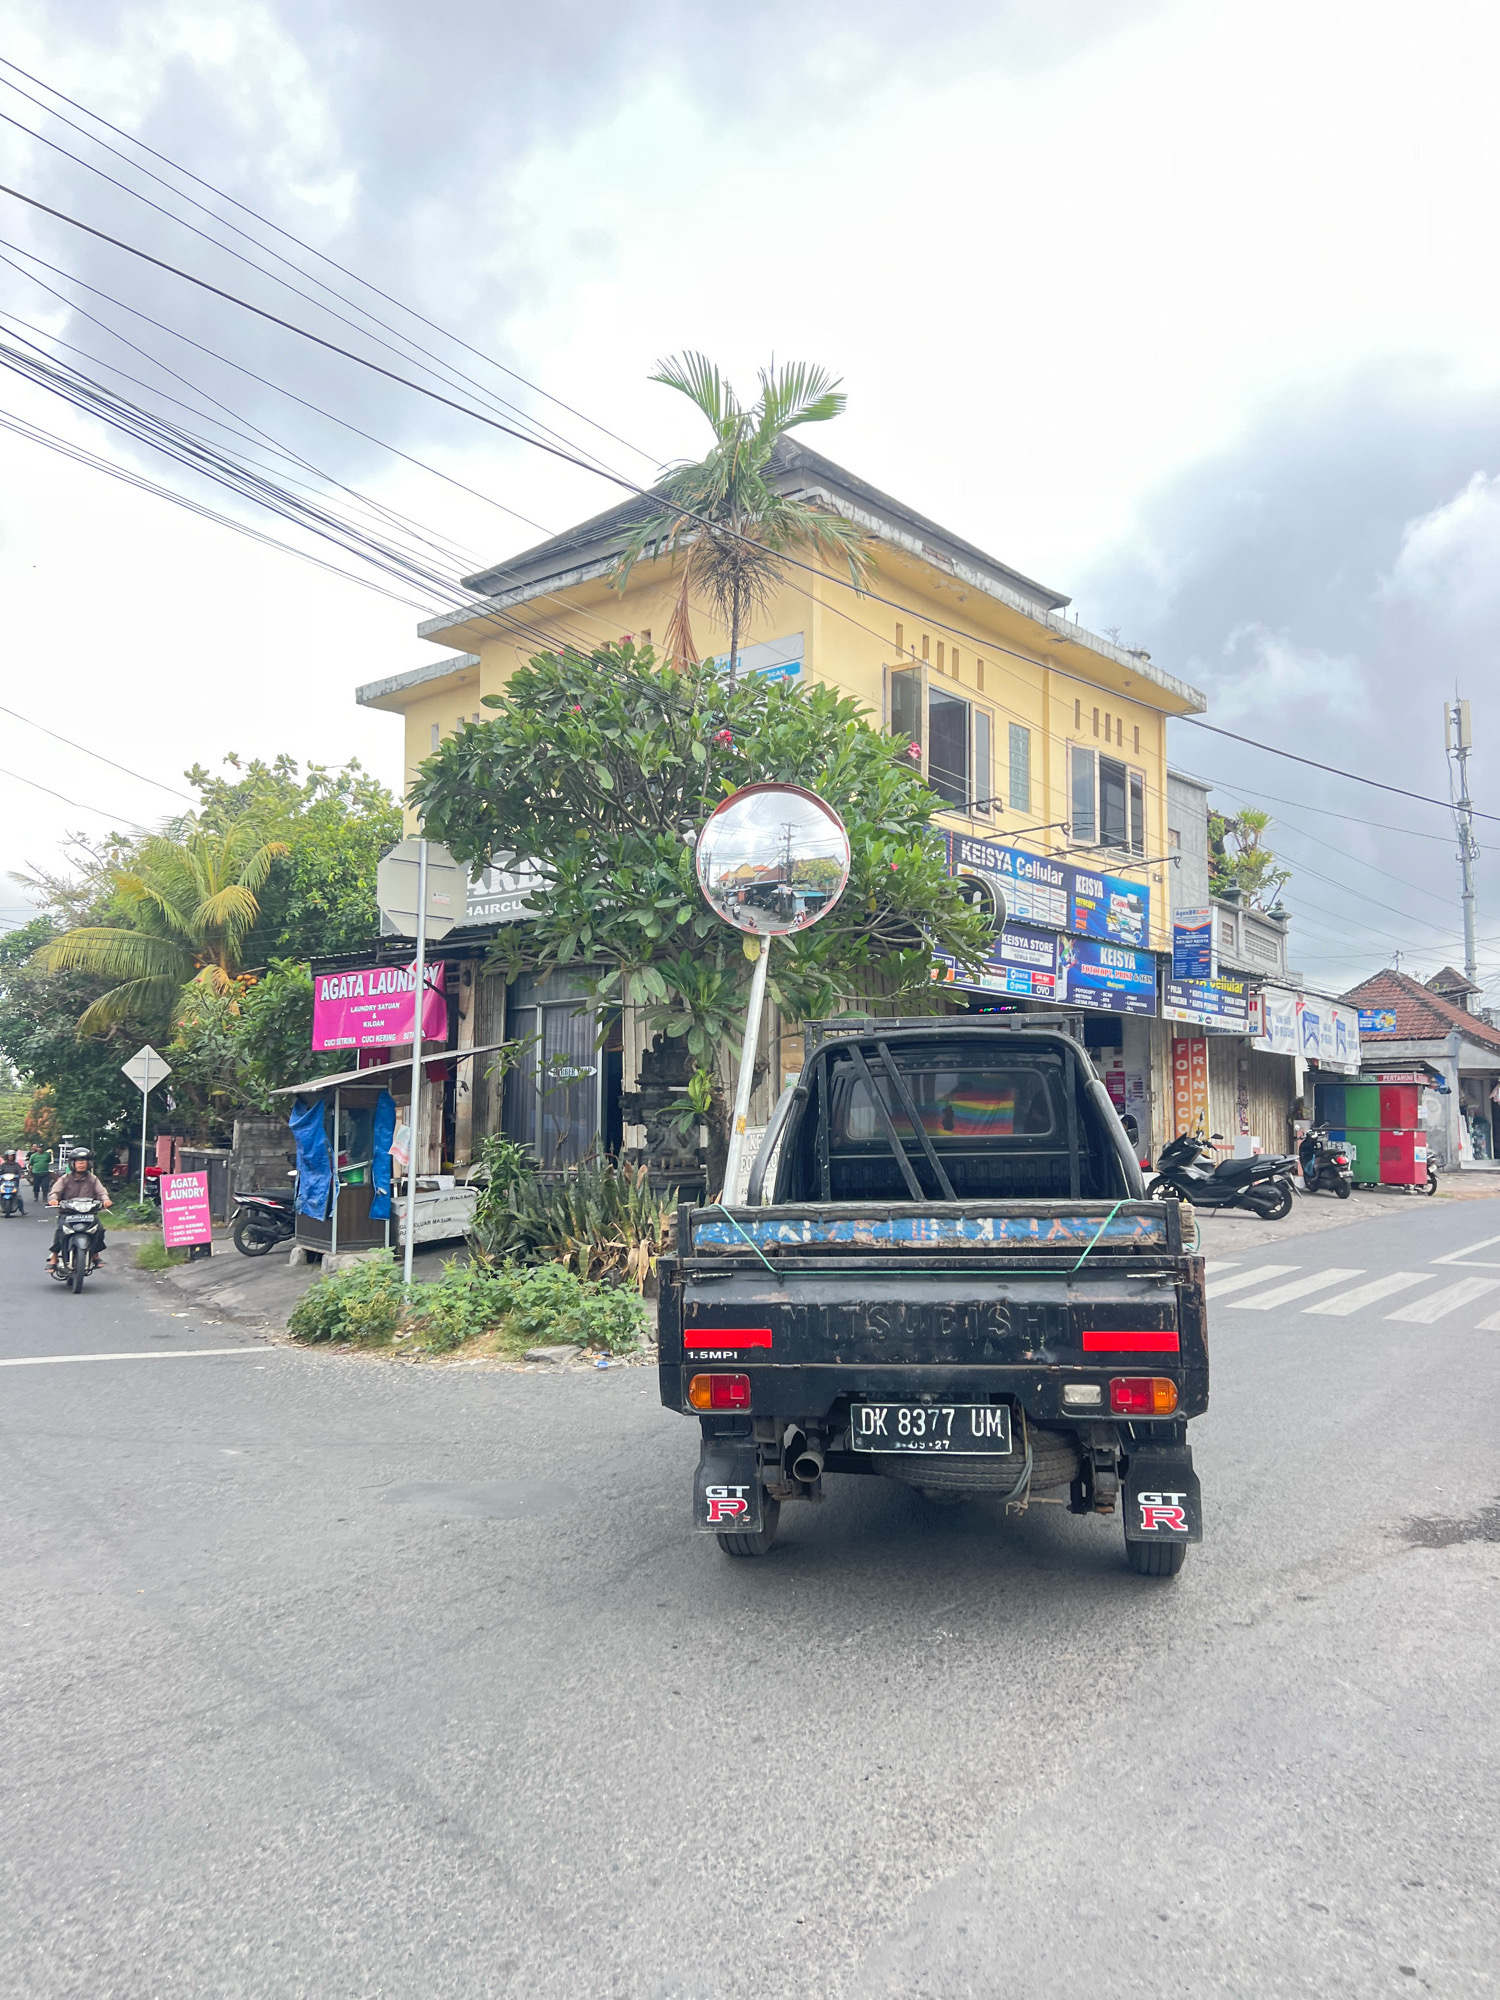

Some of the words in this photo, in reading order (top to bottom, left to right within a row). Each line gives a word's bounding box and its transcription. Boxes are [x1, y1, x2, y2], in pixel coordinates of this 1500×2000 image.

[962, 840, 1012, 872] KEISYA
[1016, 857, 1064, 886] Cellular
[1076, 874, 1104, 898] KEISYA
[1002, 933, 1029, 948] KEISYA
[1030, 939, 1054, 954] STORE
[1100, 947, 1136, 970] KEISYA
[1115, 969, 1132, 980] PRINT
[1134, 973, 1138, 982] &
[320, 974, 364, 1001] AGATA
[1036, 986, 1050, 996] OVO
[350, 1004, 376, 1012] LAUNDRY
[378, 1002, 400, 1010] SATUAN
[363, 1020, 384, 1028] KILOAN
[324, 1038, 336, 1046] CUCI
[335, 1036, 356, 1046] SETRIKA
[362, 1035, 375, 1043] CUCI
[376, 1034, 396, 1042] KERING
[171, 1177, 198, 1189] AGATA
[166, 1187, 204, 1200] LAUNDRY
[412, 1220, 432, 1228] ELUAR
[861, 1408, 888, 1436] DK
[898, 1408, 956, 1436] 8377
[971, 1408, 1003, 1438] UM
[706, 1486, 750, 1498] GT
[1138, 1492, 1187, 1505] GT
[706, 1498, 749, 1522] R
[1140, 1505, 1188, 1531] R
